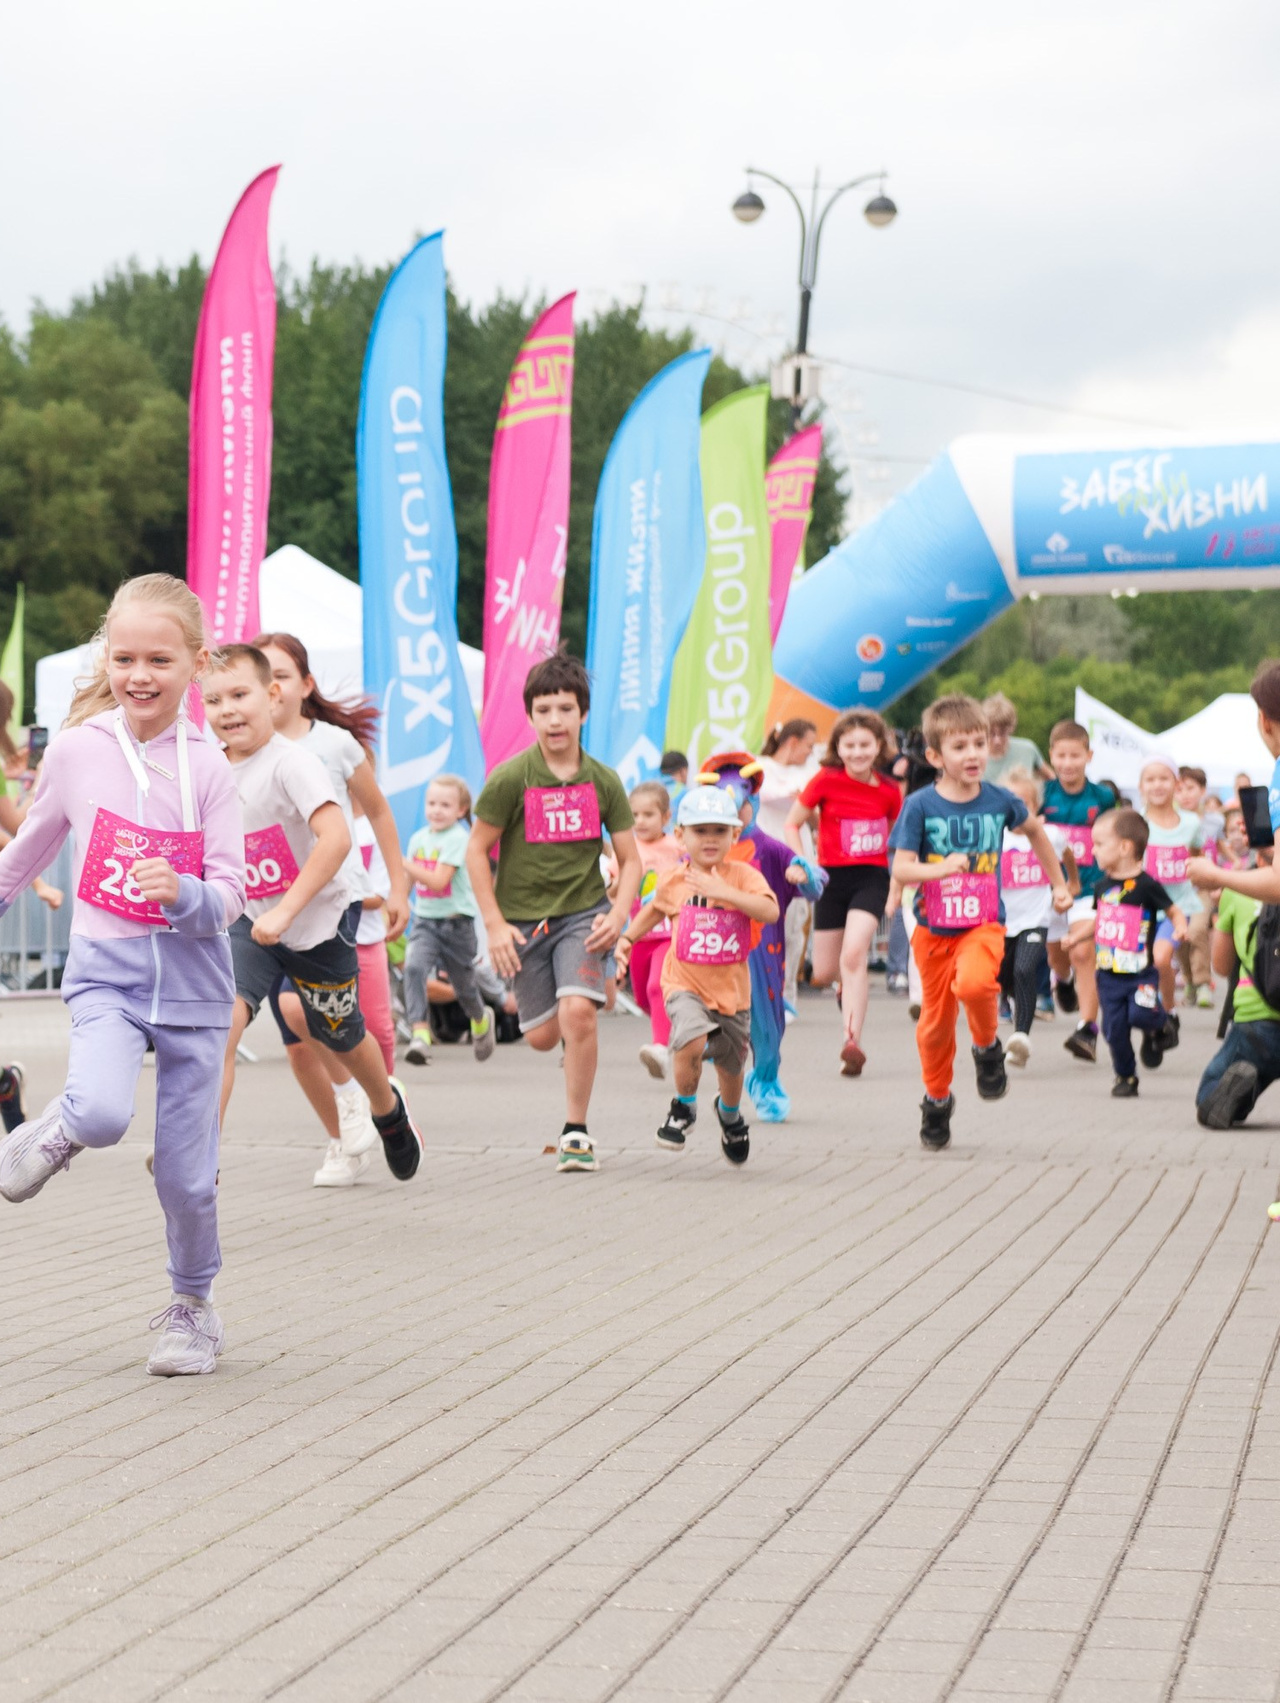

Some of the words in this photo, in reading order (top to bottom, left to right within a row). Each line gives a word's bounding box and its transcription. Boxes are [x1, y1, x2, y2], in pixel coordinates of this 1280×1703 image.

[1058, 453, 1172, 516] ЗАБЕГ
[705, 502, 757, 752] X5Group
[545, 809, 582, 833] 113
[925, 813, 1005, 853] RUN
[99, 858, 147, 903] 28
[245, 858, 282, 888] 00
[942, 896, 981, 919] 118
[689, 931, 740, 955] 294
[1097, 919, 1126, 942] 291
